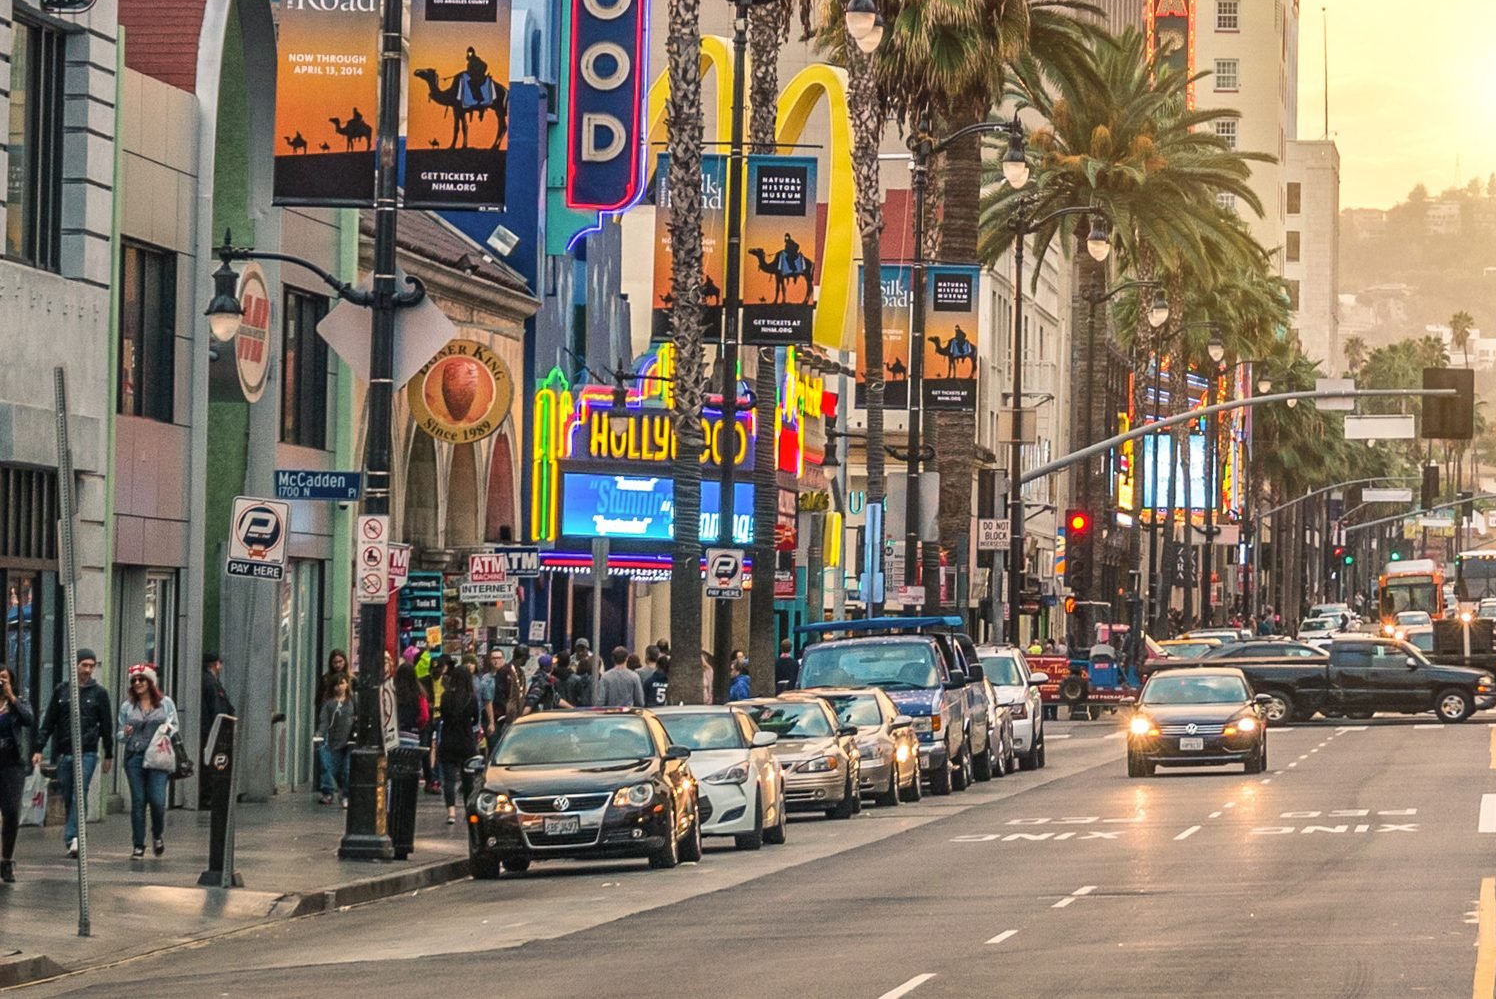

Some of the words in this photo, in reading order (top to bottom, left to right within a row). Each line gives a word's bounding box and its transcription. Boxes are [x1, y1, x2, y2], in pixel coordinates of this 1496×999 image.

[288, 53, 314, 63] NOW
[316, 54, 367, 64] THROUGH
[294, 65, 323, 75] APRIL
[341, 66, 363, 76] 2014
[421, 172, 438, 180] GET
[440, 172, 475, 181] TICKETS
[476, 173, 489, 181] AT
[762, 176, 801, 184] NATURAL
[431, 183, 477, 192] NHM.ORG
[472, 344, 505, 381] KING
[423, 417, 458, 441] Since
[463, 420, 491, 441] 1989
[278, 472, 346, 488] McCadden
[278, 486, 300, 497] 1700
[303, 487, 310, 497] N
[983, 521, 993, 530] DO
[996, 521, 1009, 530] NOT
[985, 532, 1008, 540] BLOCK
[472, 556, 504, 573] ATM
[1177, 546, 1185, 580] ZARA
[230, 563, 249, 574] PAY
[253, 565, 280, 578] HERE
[473, 573, 504, 581] MACHINE
[462, 584, 513, 593] INTERNET
[656, 688, 666, 702] 5
